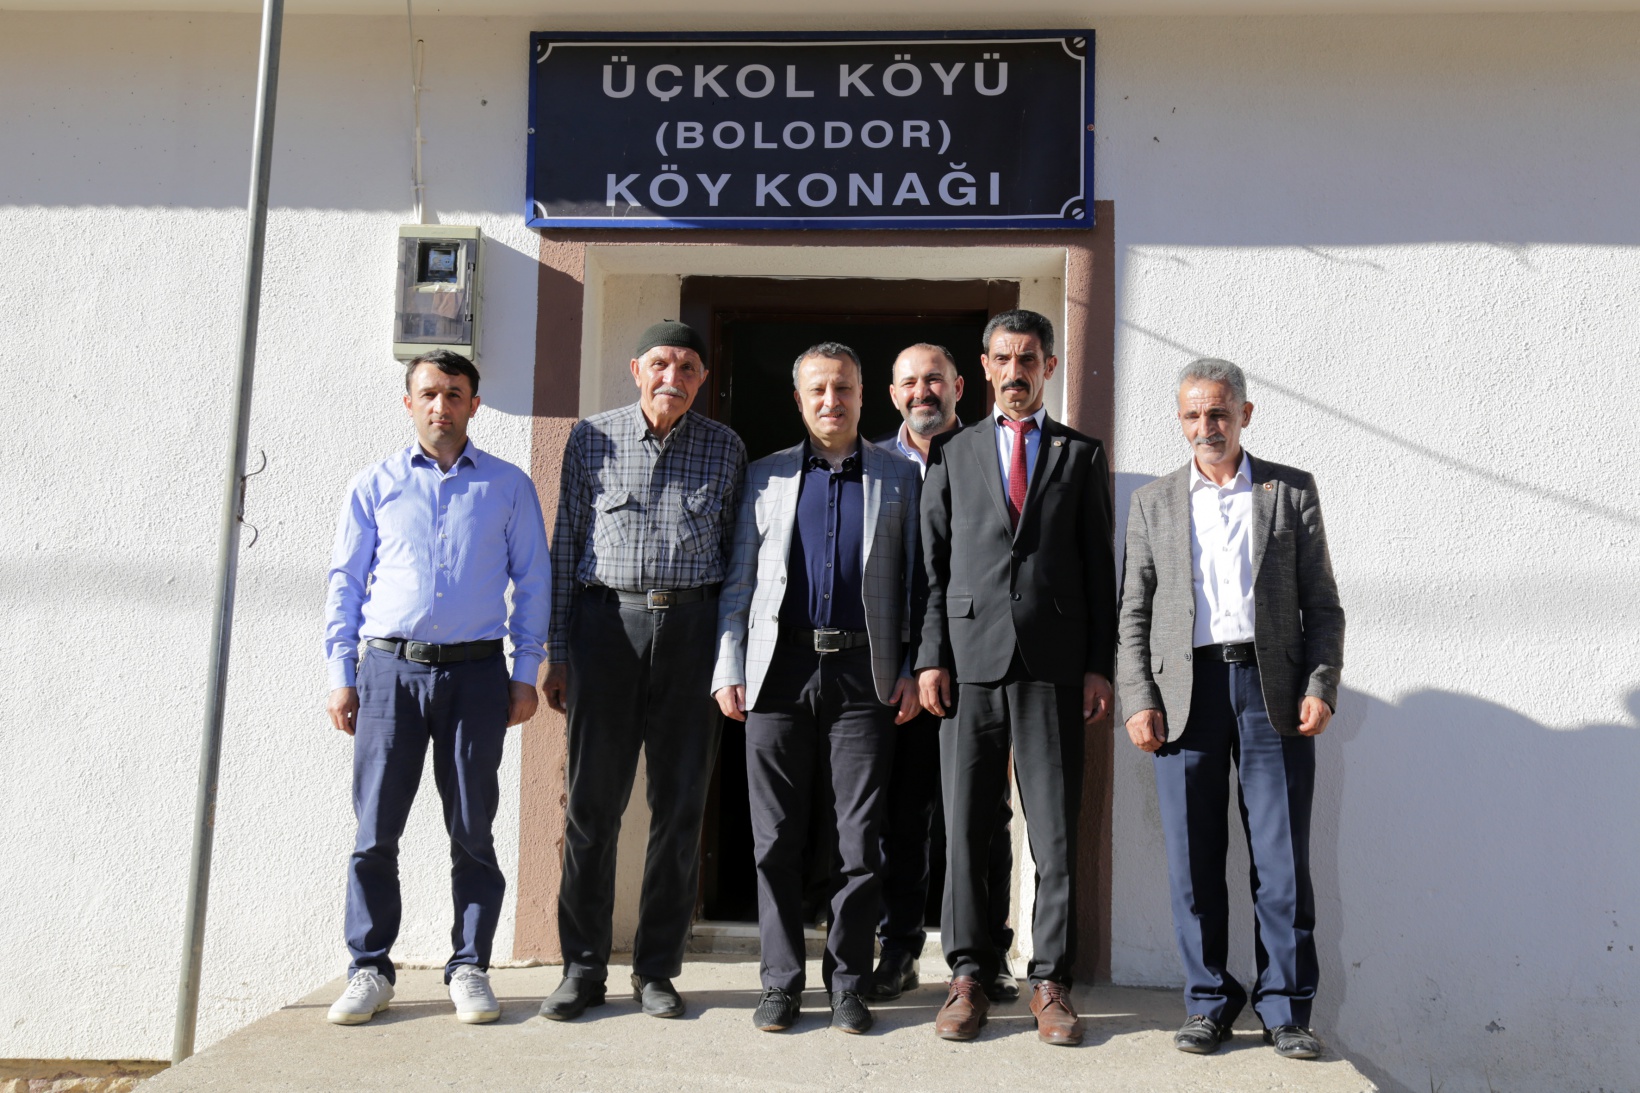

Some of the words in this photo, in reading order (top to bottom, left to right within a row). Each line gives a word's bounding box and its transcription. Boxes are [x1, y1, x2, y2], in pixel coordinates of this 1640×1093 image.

[602, 55, 815, 102] ÜÇKOL
[839, 53, 1009, 97] KÖYÜ
[655, 120, 952, 156] (BOLODOR)
[606, 164, 732, 207] KÖY
[756, 162, 1000, 207] KONAĞI
